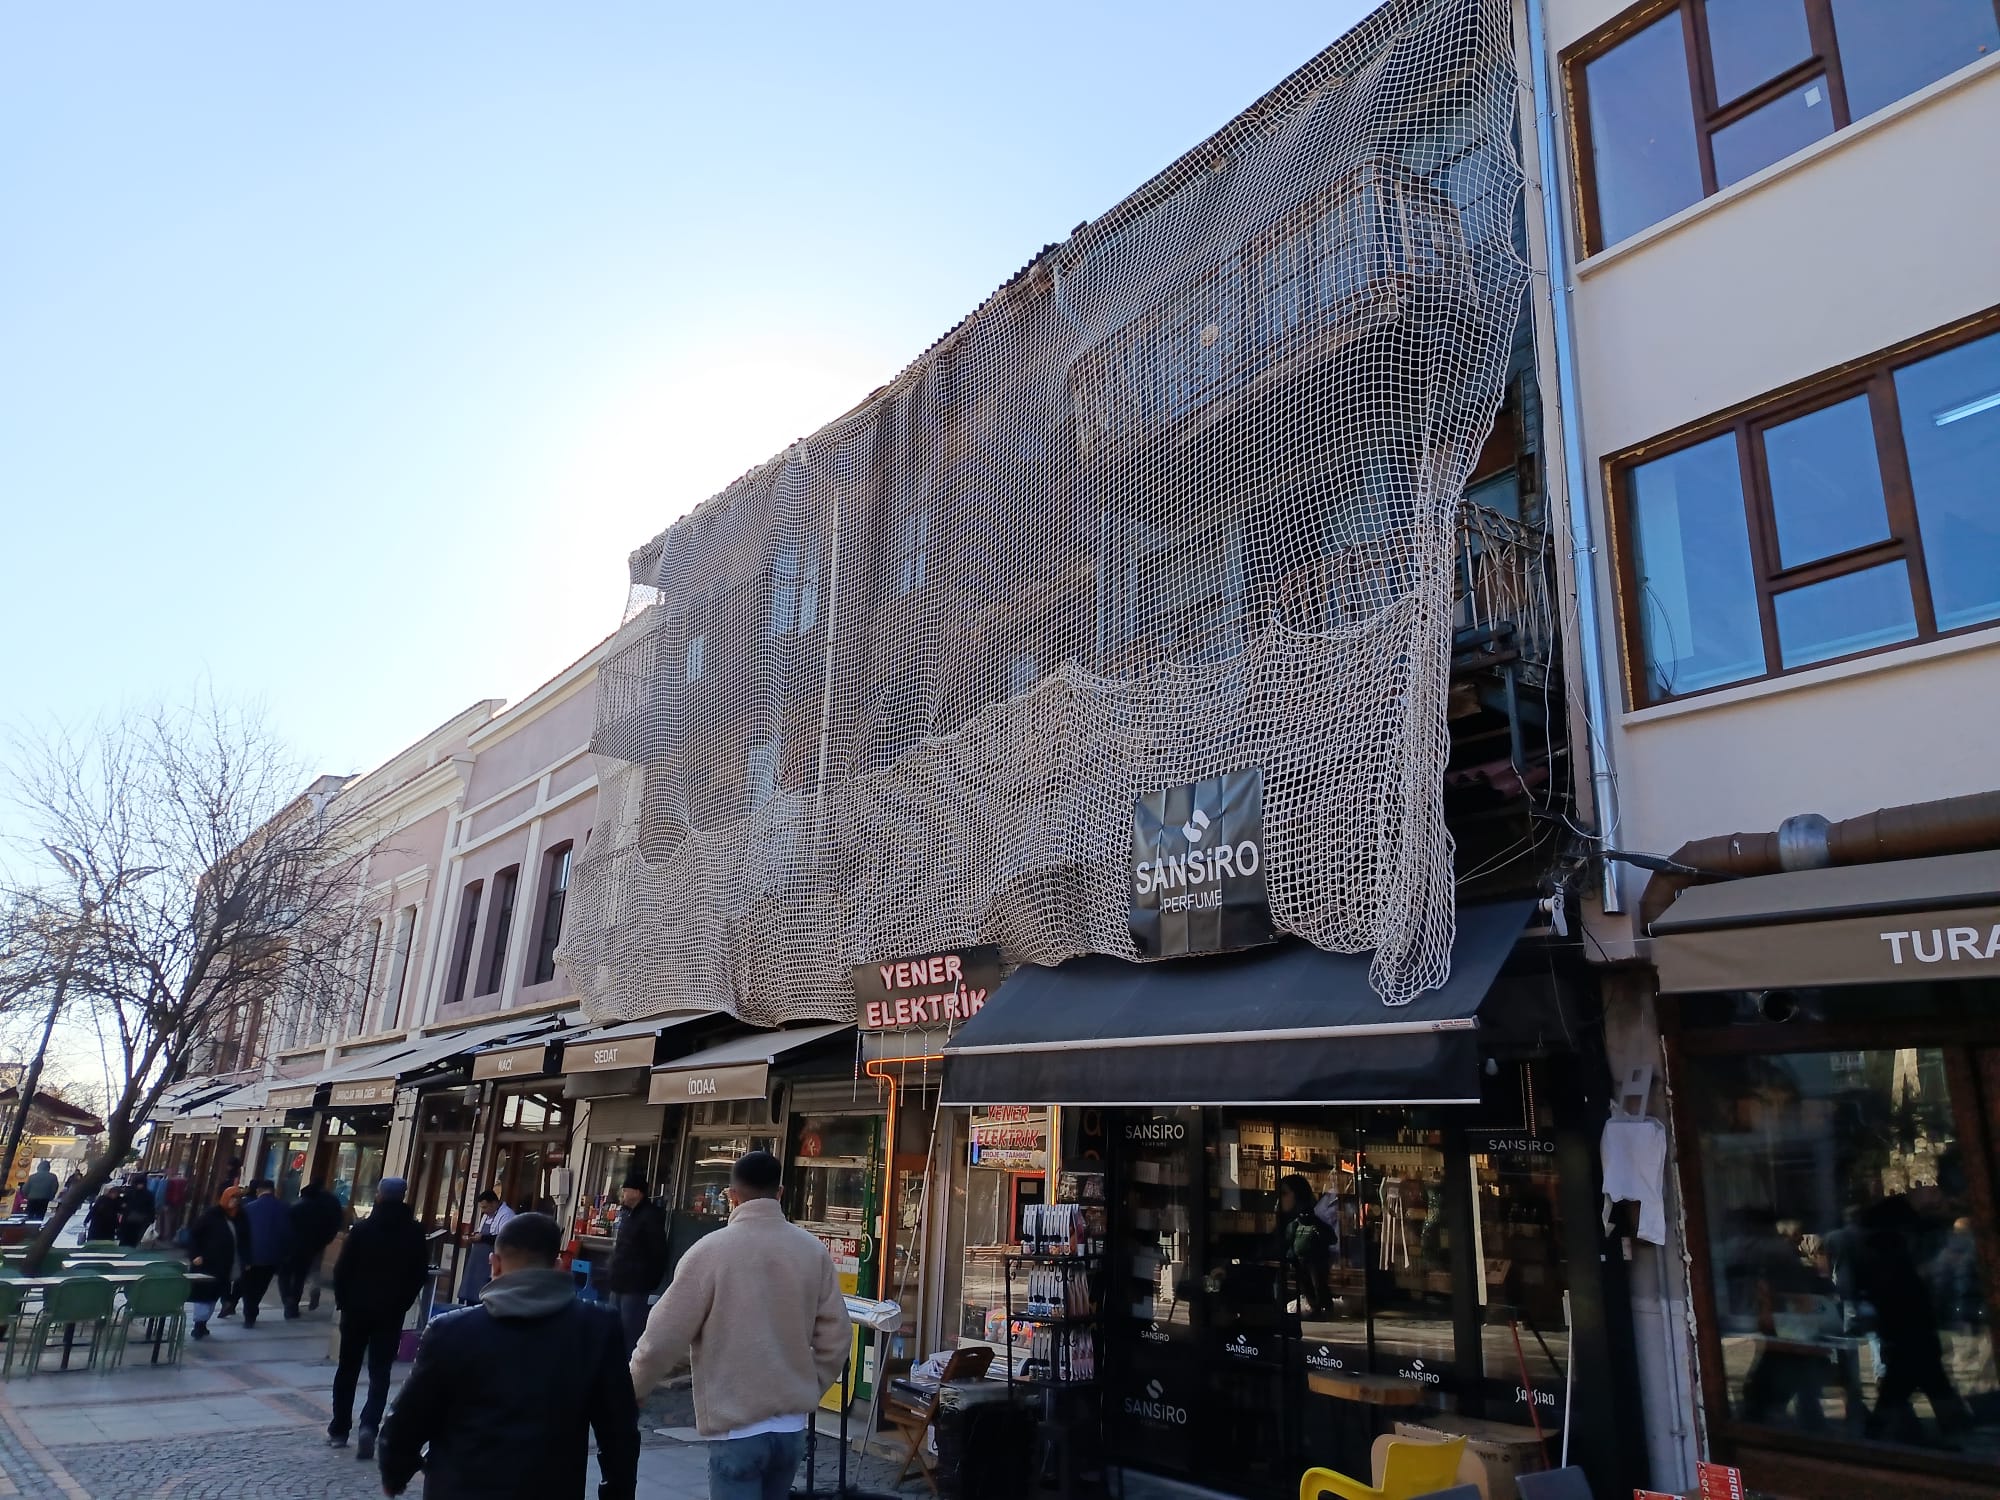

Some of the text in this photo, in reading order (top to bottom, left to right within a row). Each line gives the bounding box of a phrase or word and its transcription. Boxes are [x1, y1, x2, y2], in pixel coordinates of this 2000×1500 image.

[1164, 889, 1223, 914] PERFUME
[880, 955, 963, 991] YENER
[866, 983, 987, 1028] ELEKTRİK
[593, 1048, 619, 1065] SEDAT
[988, 1104, 1030, 1122] YENER
